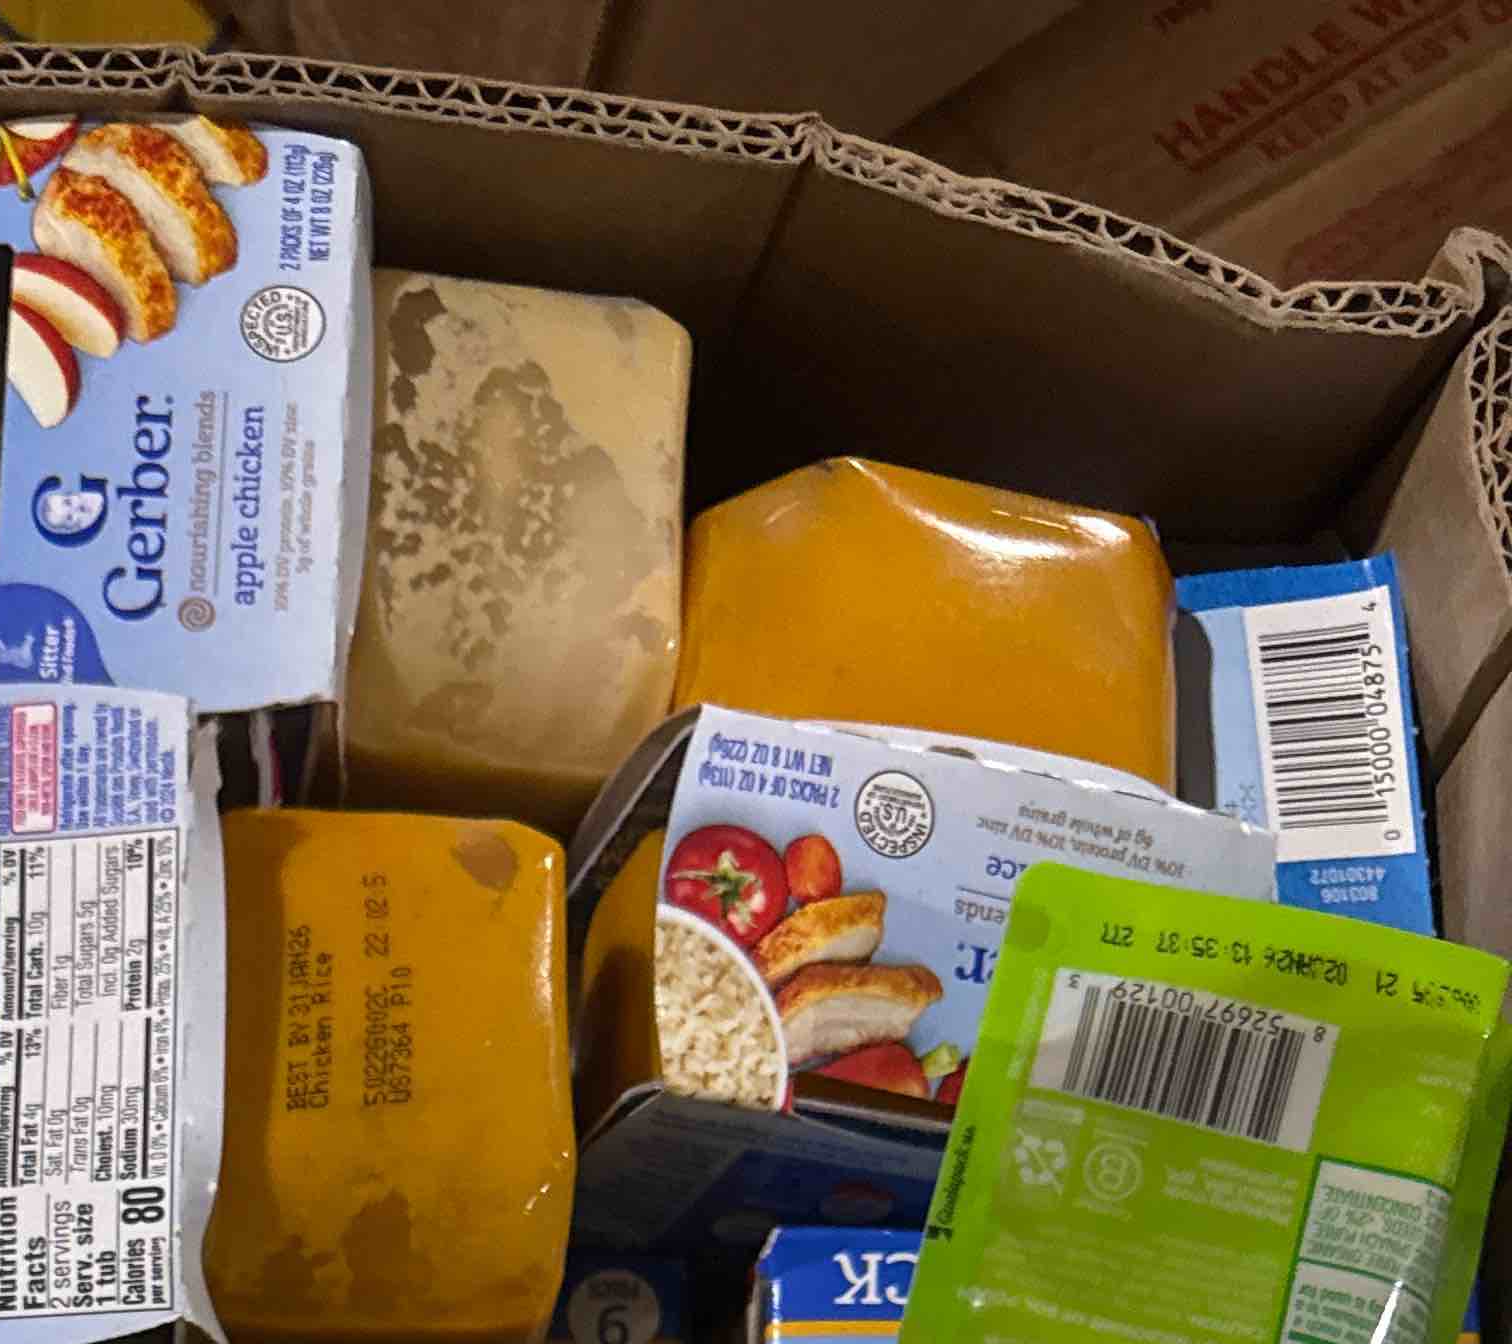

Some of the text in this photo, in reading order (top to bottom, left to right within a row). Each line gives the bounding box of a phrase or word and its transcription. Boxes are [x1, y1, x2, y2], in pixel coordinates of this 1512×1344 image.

[277, 142, 312, 271] 2 PACKS OF 4 OZ (113g)
[307, 149, 339, 262] NET WT 8 OZ (226g)
[182, 388, 219, 593] nourishing blends
[227, 403, 271, 607] apple chicken
[38, 623, 62, 679] Sitter
[1359, 601, 1401, 841] 0 15000 04875 4
[21, 1027, 43, 1057] 13%
[1067, 972, 1326, 1042] 8 52697 00129 3
[18, 1122, 39, 1146] Fat
[91, 1083, 118, 1183] Cholest. 10mg
[118, 1084, 144, 1180] Sodium 30mg
[285, 1060, 309, 1112] BEST
[17, 1147, 40, 1185] Total
[19, 1235, 48, 1310] Facts
[46, 1198, 78, 1310] 2 servings
[72, 1202, 97, 1308] Serv. size
[120, 1183, 167, 1306] Calories 80
